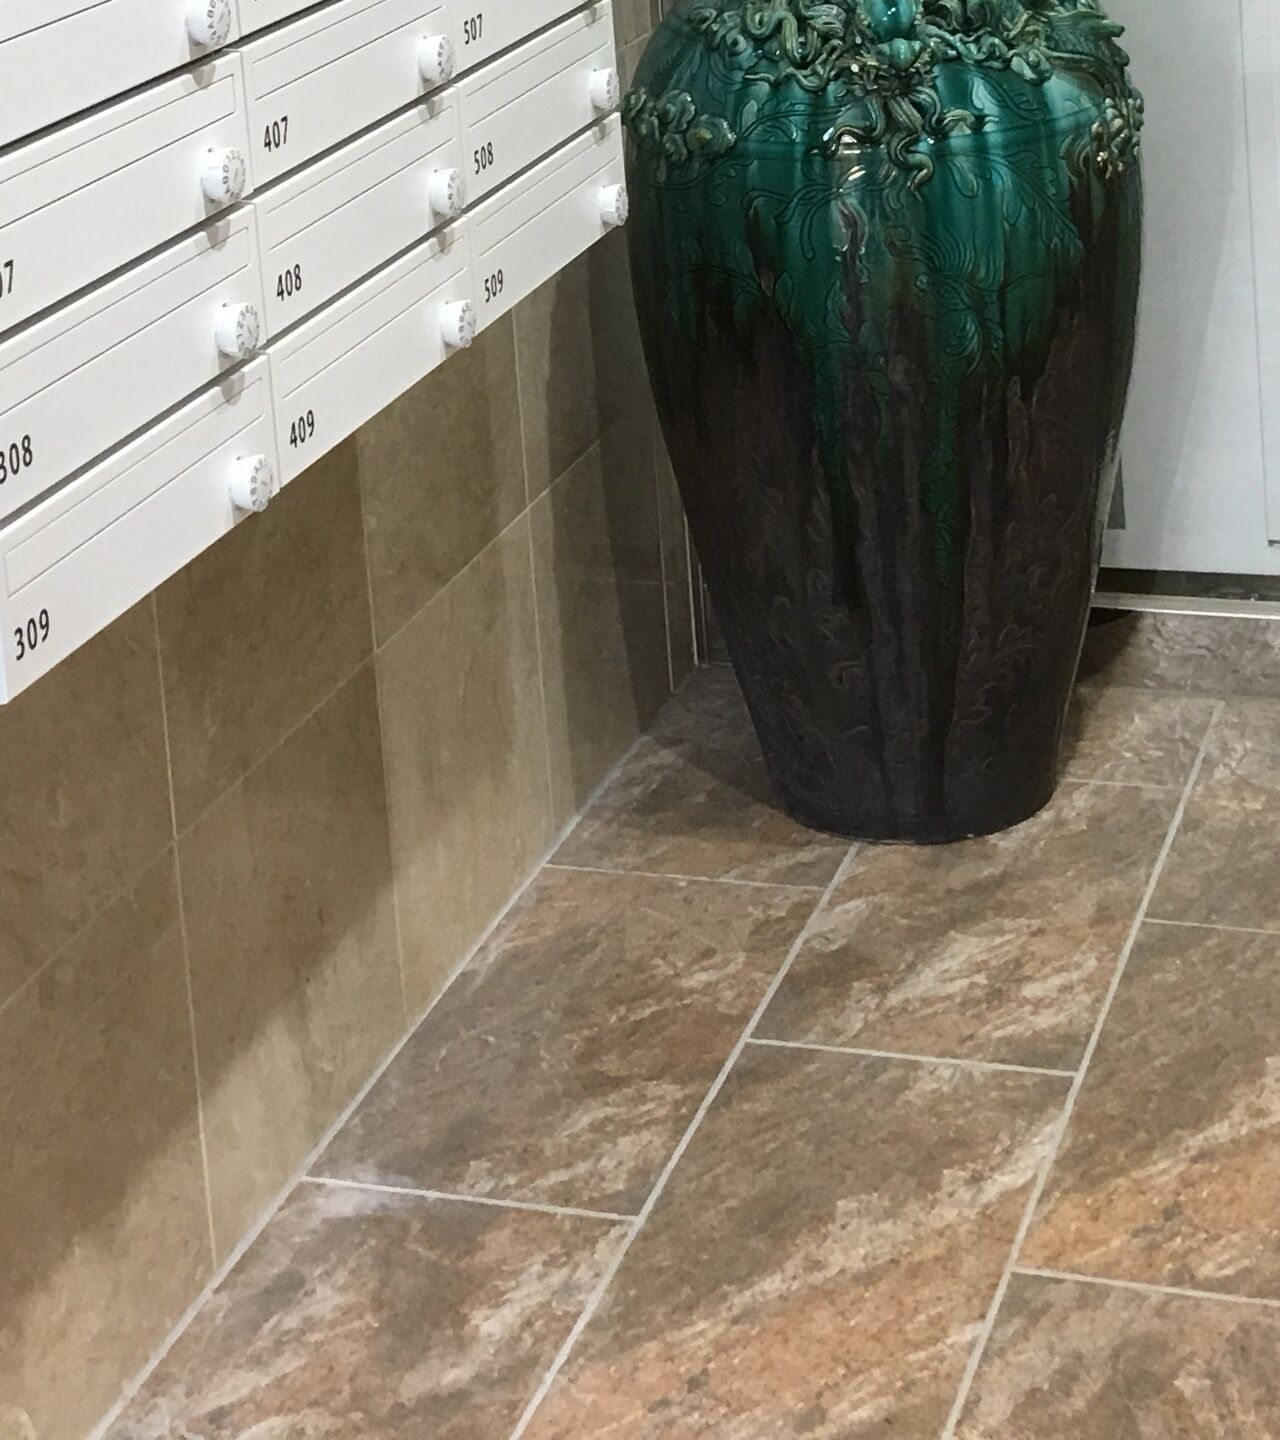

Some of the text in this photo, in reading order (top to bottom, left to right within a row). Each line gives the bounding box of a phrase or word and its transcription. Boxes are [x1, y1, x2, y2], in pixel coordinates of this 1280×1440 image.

[463, 13, 483, 45] 507
[263, 115, 288, 153] 407
[473, 141, 494, 175] 508
[276, 263, 302, 301] 408
[484, 268, 504, 304] 509
[289, 409, 315, 448] 409
[13, 608, 50, 661] 309
